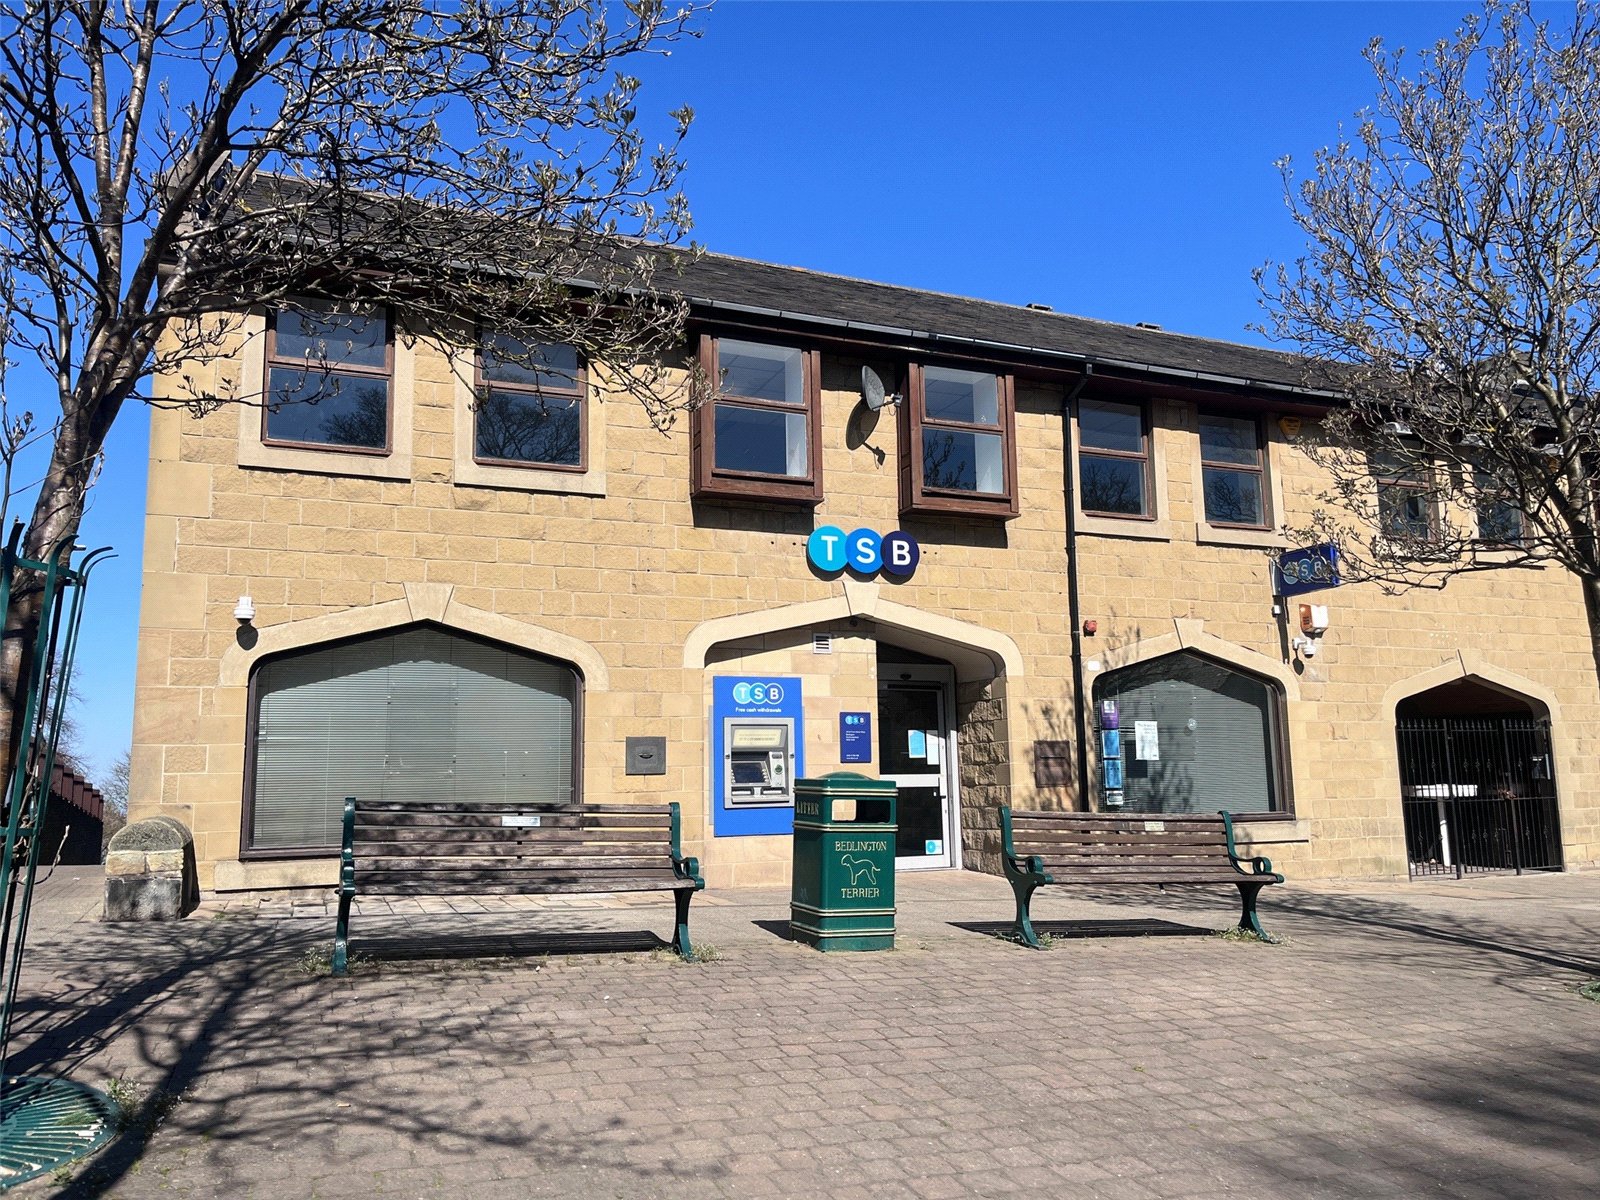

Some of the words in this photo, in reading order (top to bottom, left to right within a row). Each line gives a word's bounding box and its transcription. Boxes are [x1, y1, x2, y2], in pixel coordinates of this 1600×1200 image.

[820, 535, 911, 566] TSB
[796, 801, 819, 815] LITTER
[835, 841, 887, 852] BEDLINGTON
[841, 888, 880, 899] TERRIER
